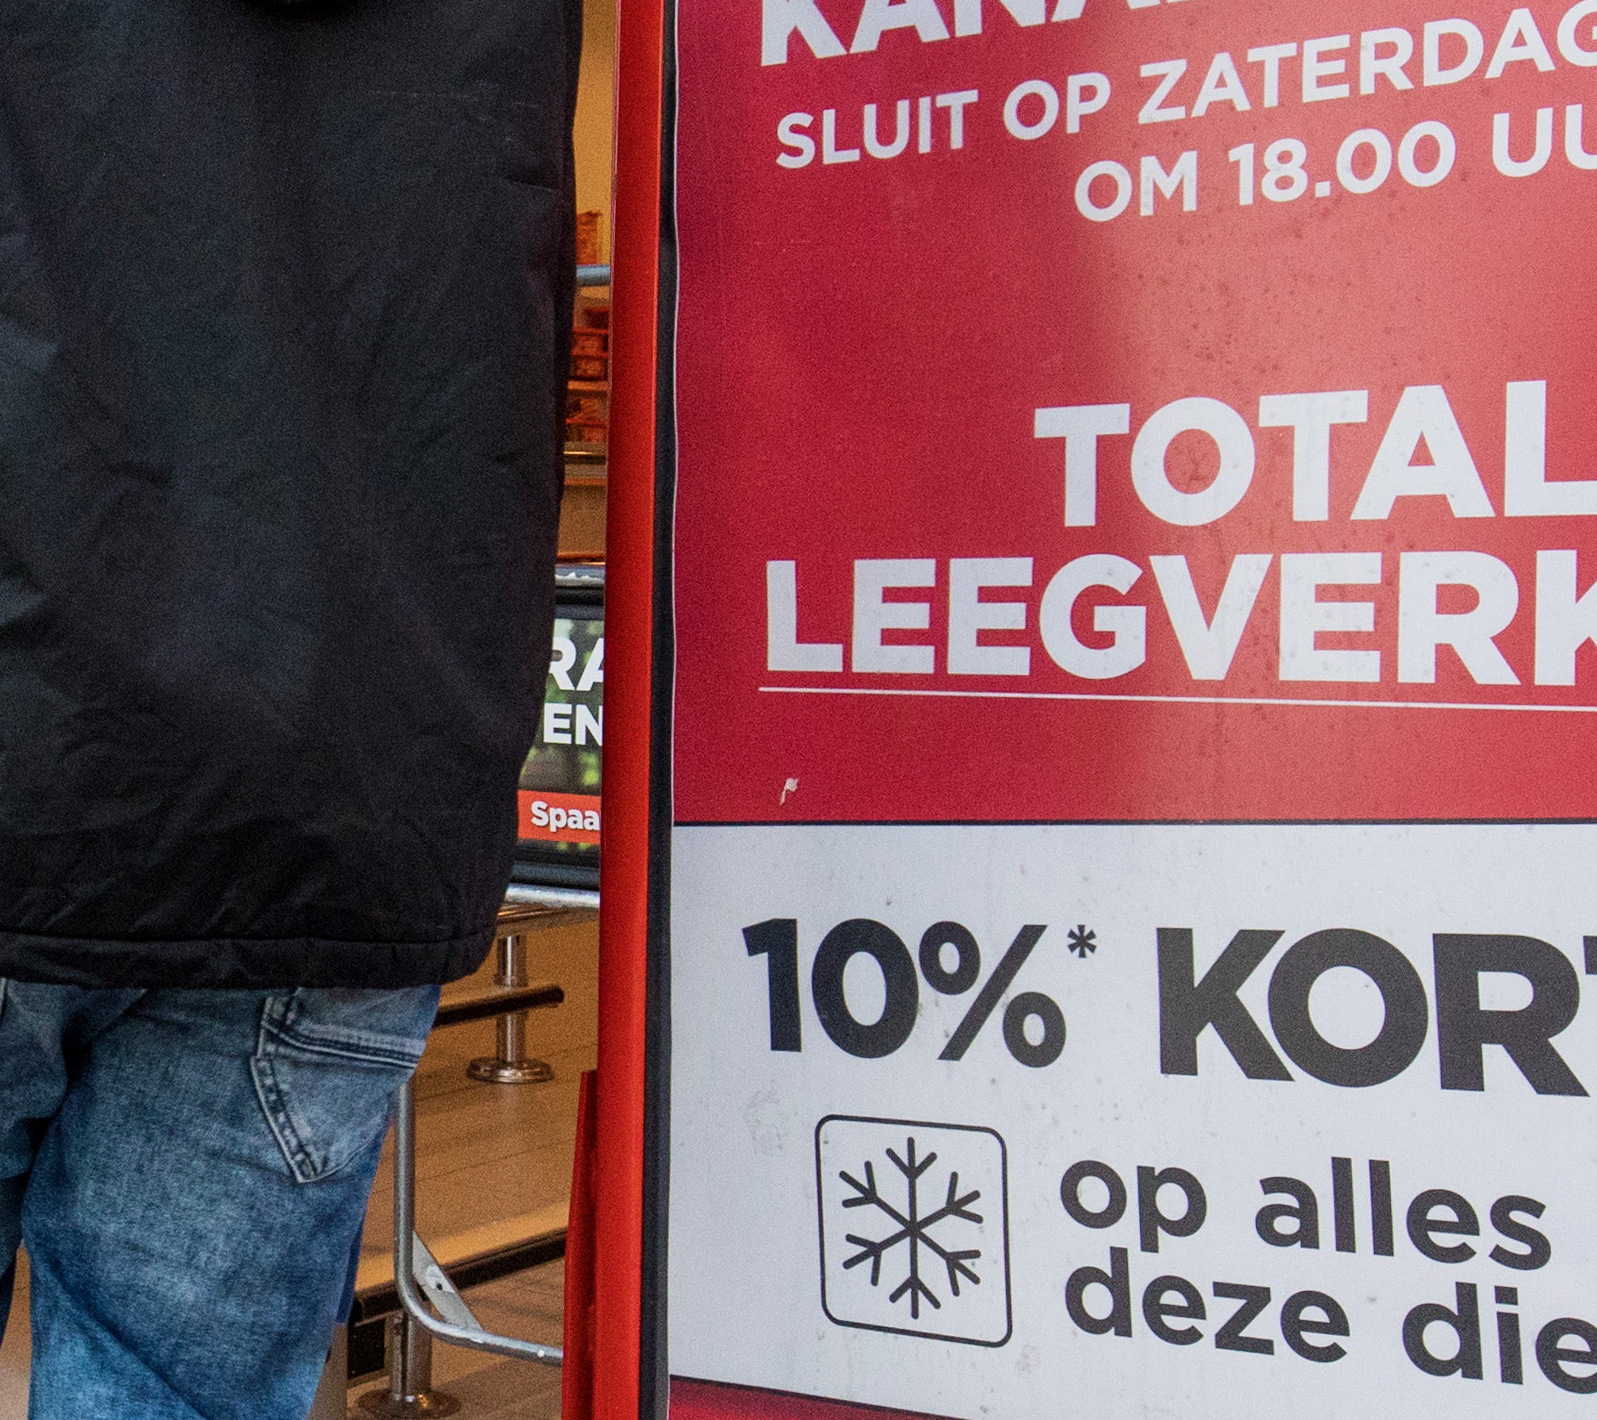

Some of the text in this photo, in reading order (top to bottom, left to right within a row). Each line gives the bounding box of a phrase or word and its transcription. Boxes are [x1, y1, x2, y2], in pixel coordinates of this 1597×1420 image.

[773, 86, 972, 170] SLUIT
[1003, 73, 1112, 143] OP
[1073, 157, 1198, 225] OM
[1227, 120, 1460, 209] 18.00
[1058, 1157, 1210, 1242] op
[1253, 1155, 1554, 1272] alles
[1063, 1247, 1353, 1364] deze
